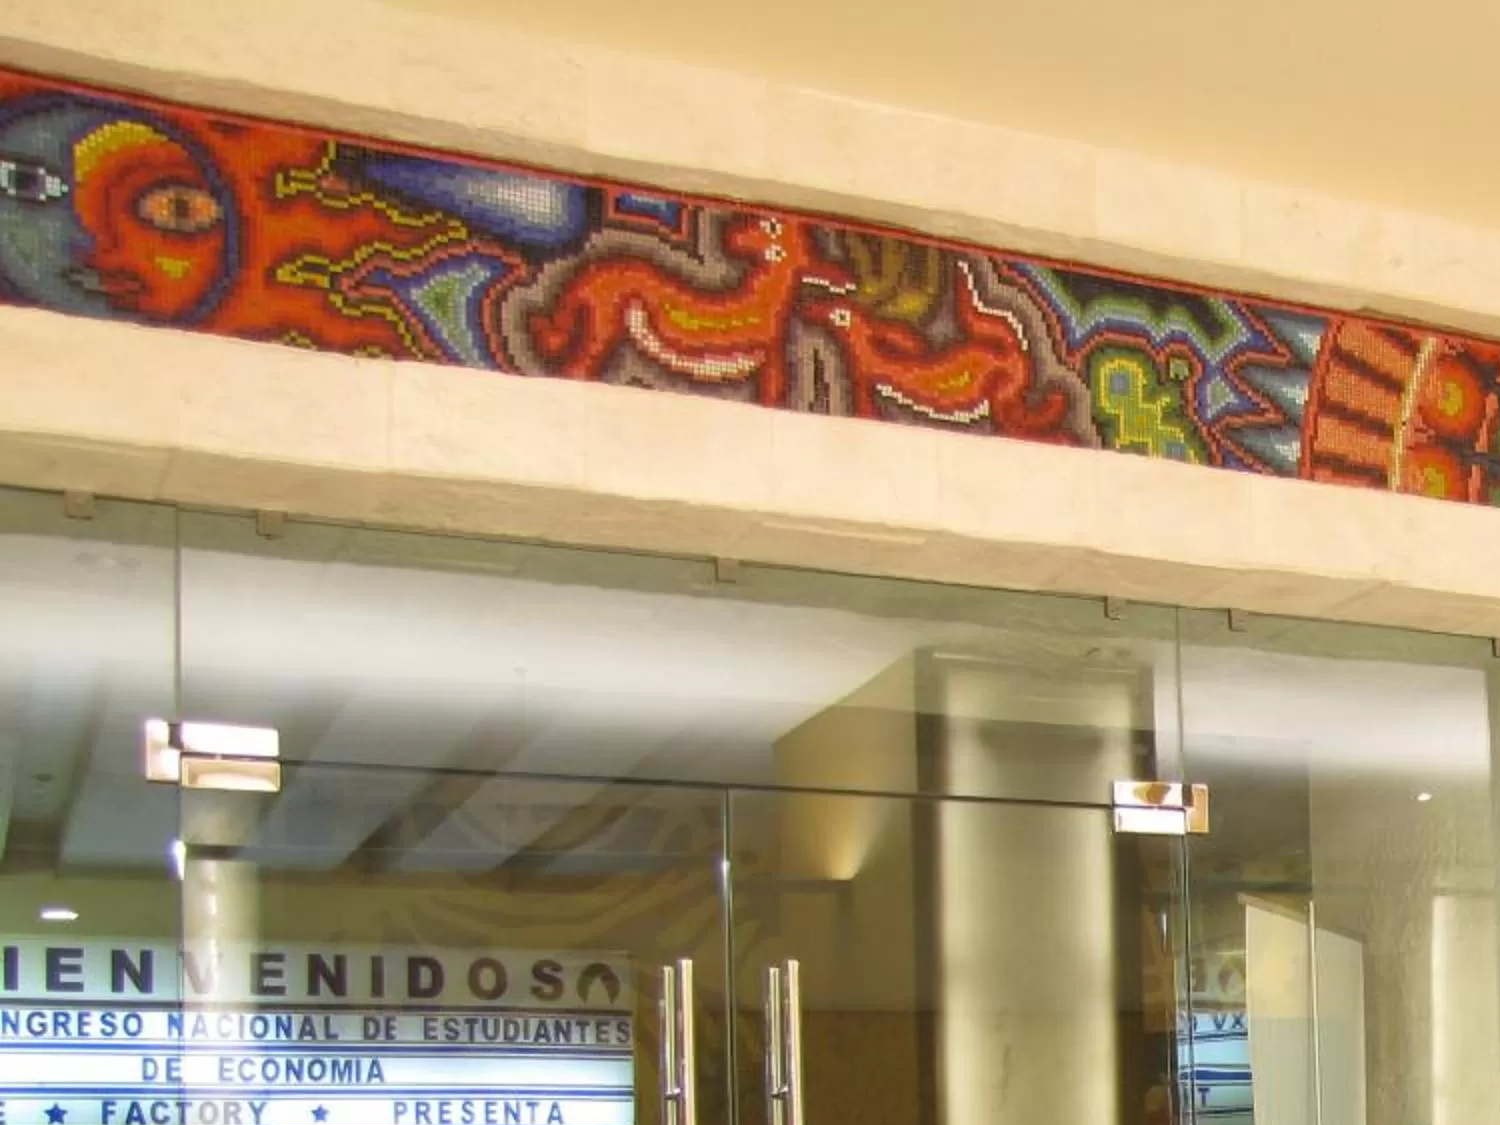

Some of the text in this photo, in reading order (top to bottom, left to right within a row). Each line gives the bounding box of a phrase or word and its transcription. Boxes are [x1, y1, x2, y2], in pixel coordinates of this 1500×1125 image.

[166, 1014, 340, 1040] NACIONAL
[363, 1016, 397, 1040] DE
[423, 1017, 631, 1044] ESTUDIANTES
[141, 1057, 386, 1083] DE ECONOMIA
[101, 1100, 565, 1125] FACTORY PRESENTA
